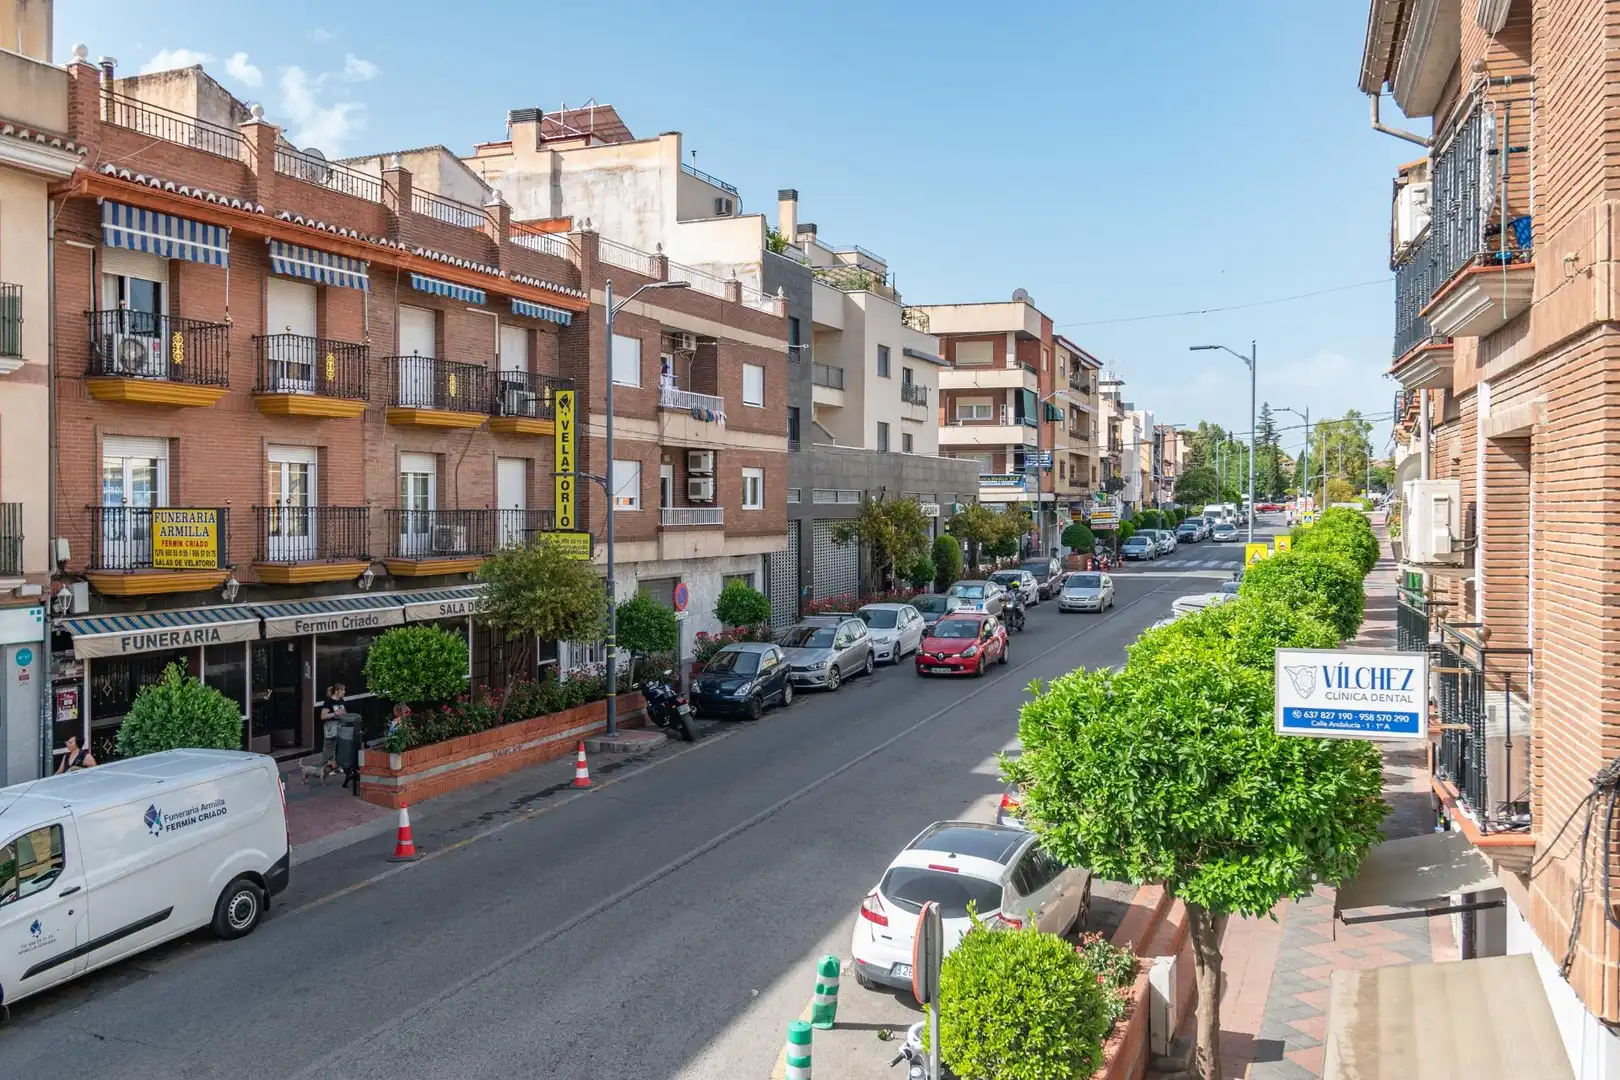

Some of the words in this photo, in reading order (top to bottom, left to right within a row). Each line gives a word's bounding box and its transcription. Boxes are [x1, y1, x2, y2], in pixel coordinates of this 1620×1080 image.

[561, 420, 570, 527] VELATORIO
[154, 512, 215, 523] FUNERARIA
[160, 526, 209, 537] ARMILLA
[174, 559, 183, 567] DE
[440, 603, 465, 616] SALA
[295, 618, 338, 634] Fermín
[341, 614, 379, 631] Criado
[121, 628, 221, 652] FUNERARIA
[1322, 661, 1414, 691] VÍLCHEZ
[1325, 691, 1368, 701] CLÍNICA
[1371, 693, 1413, 703] DENTAL
[1320, 711, 1335, 719] 827
[1338, 712, 1353, 720] 190
[1359, 713, 1374, 721] 958
[1376, 714, 1392, 722] 570
[1393, 715, 1409, 723] 290
[164, 805, 199, 822] Funeraria
[201, 798, 225, 812] Armilla
[198, 807, 227, 822] CRIADO
